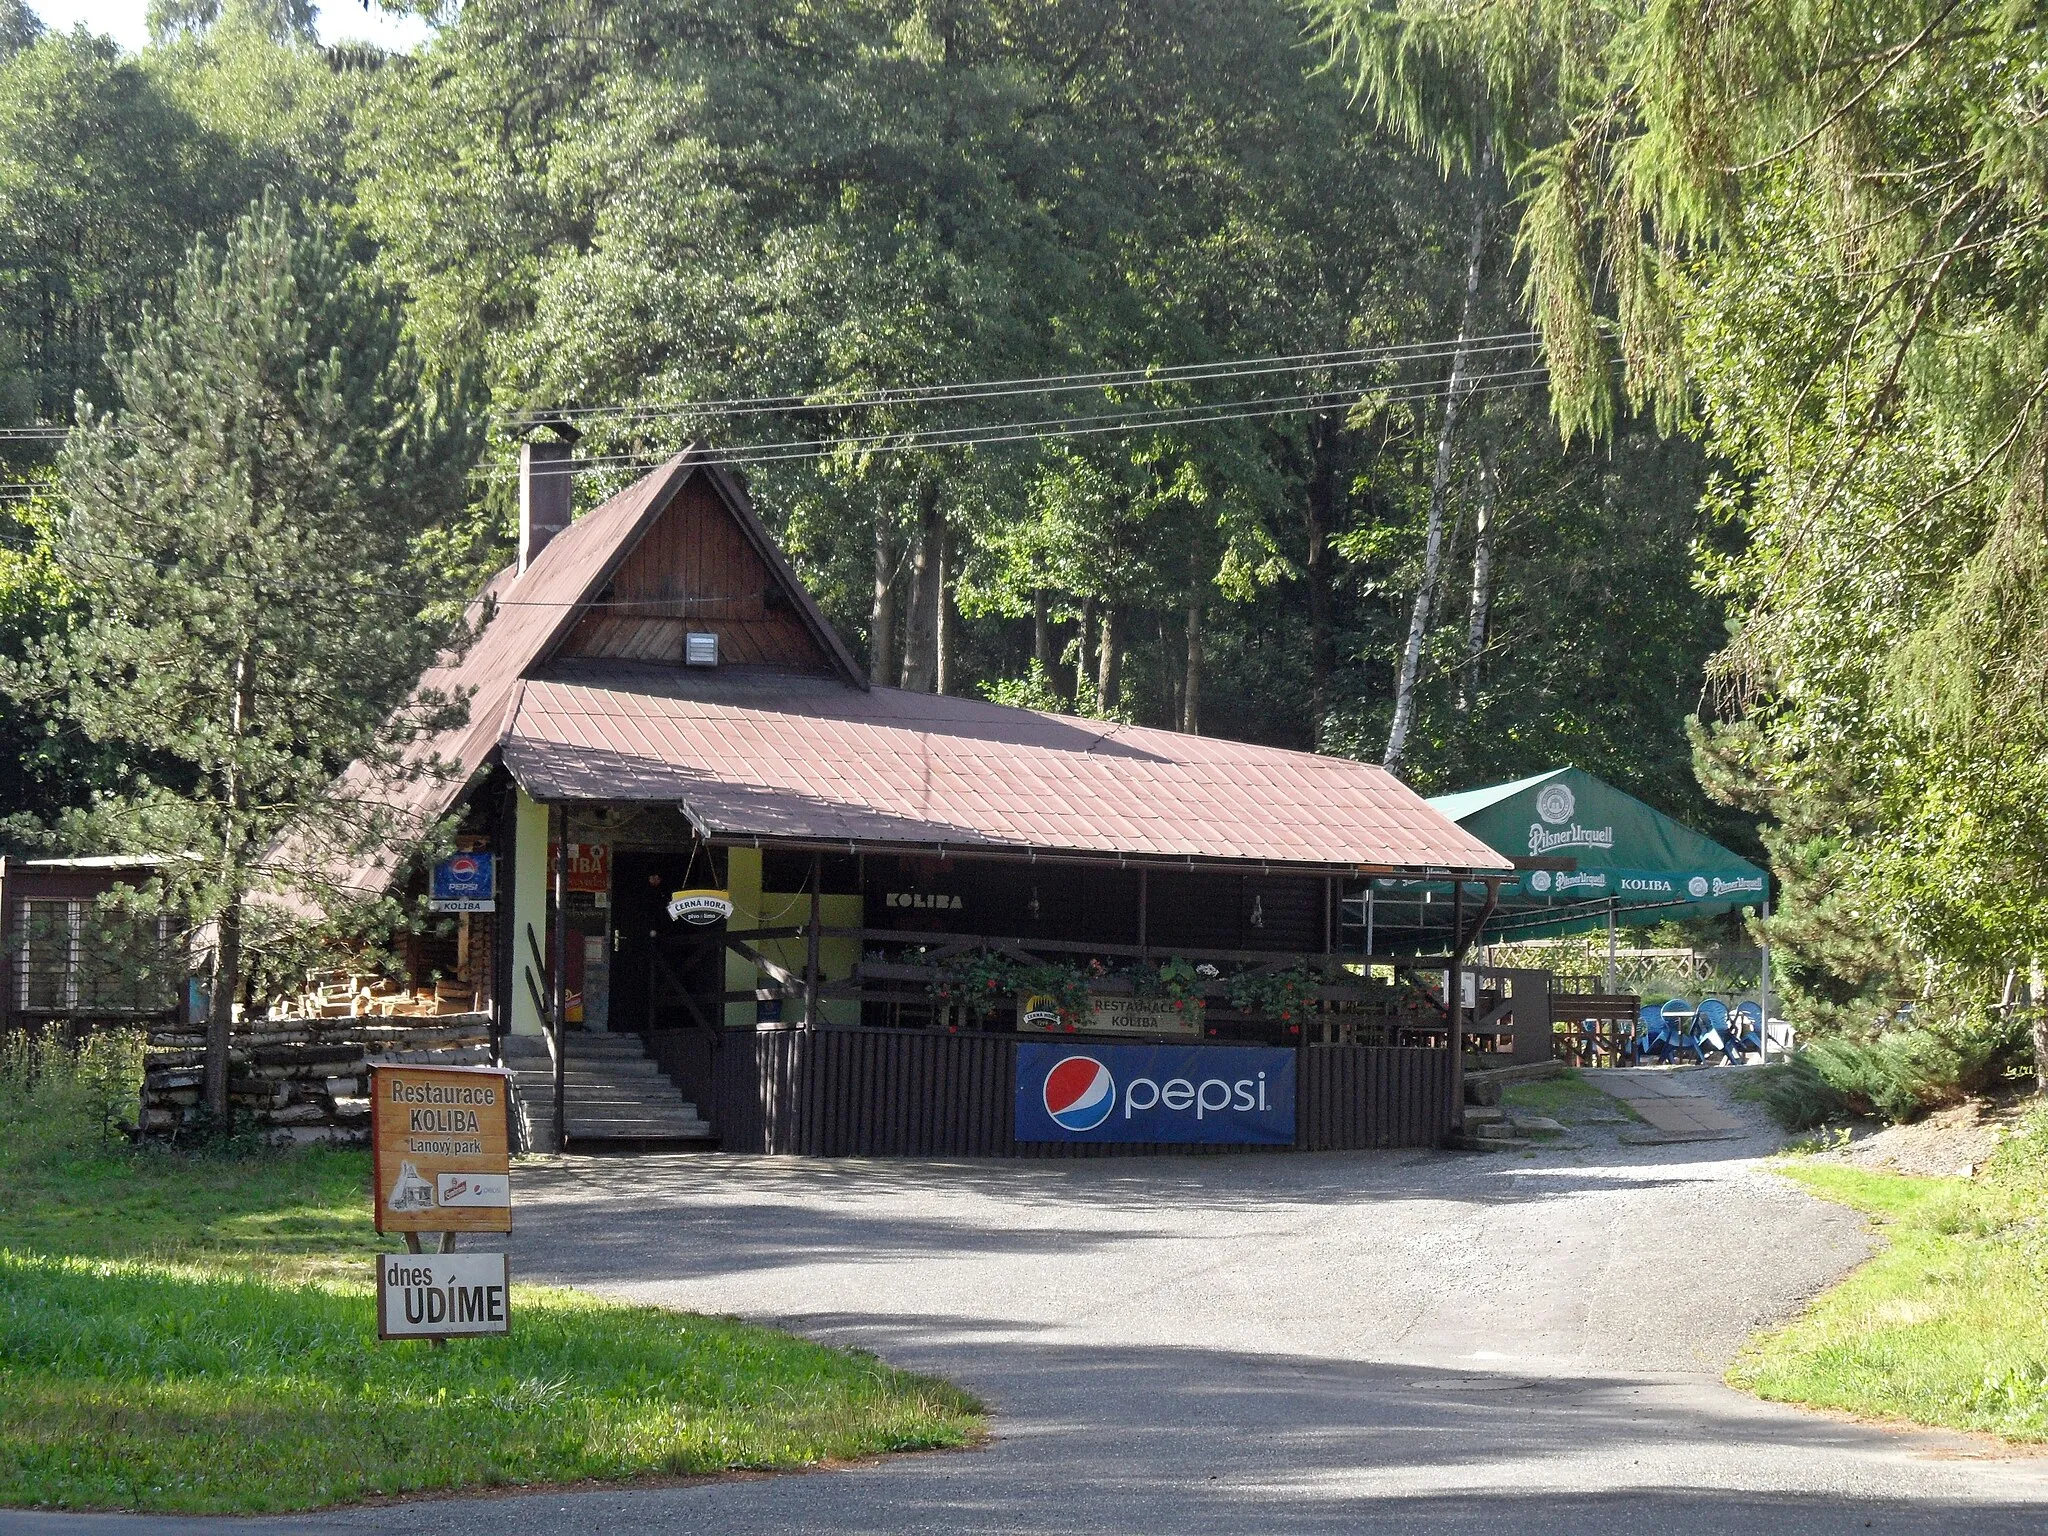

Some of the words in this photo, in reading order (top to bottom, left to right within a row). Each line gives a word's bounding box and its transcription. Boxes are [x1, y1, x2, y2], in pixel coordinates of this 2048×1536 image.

[1528, 823, 1573, 857] Pilsner
[1571, 822, 1613, 849] Urquell
[448, 883, 479, 891] PEPSI
[1621, 878, 1672, 892] KOLIBA
[444, 902, 481, 910] KOLIBA
[674, 899, 702, 912] ČERNÁ
[703, 899, 726, 911] HORA
[886, 893, 963, 909] KOLIBA
[1095, 999, 1176, 1014] RESTAURACE
[1111, 1015, 1159, 1028] KOLIBA
[392, 1080, 495, 1105] Restaurace
[1125, 1071, 1266, 1120] pepsi
[410, 1109, 479, 1132] KOLIBA
[410, 1137, 451, 1156] Lanový
[454, 1137, 482, 1155] park
[387, 1262, 433, 1287] dnes
[404, 1274, 504, 1325] UDÍME
